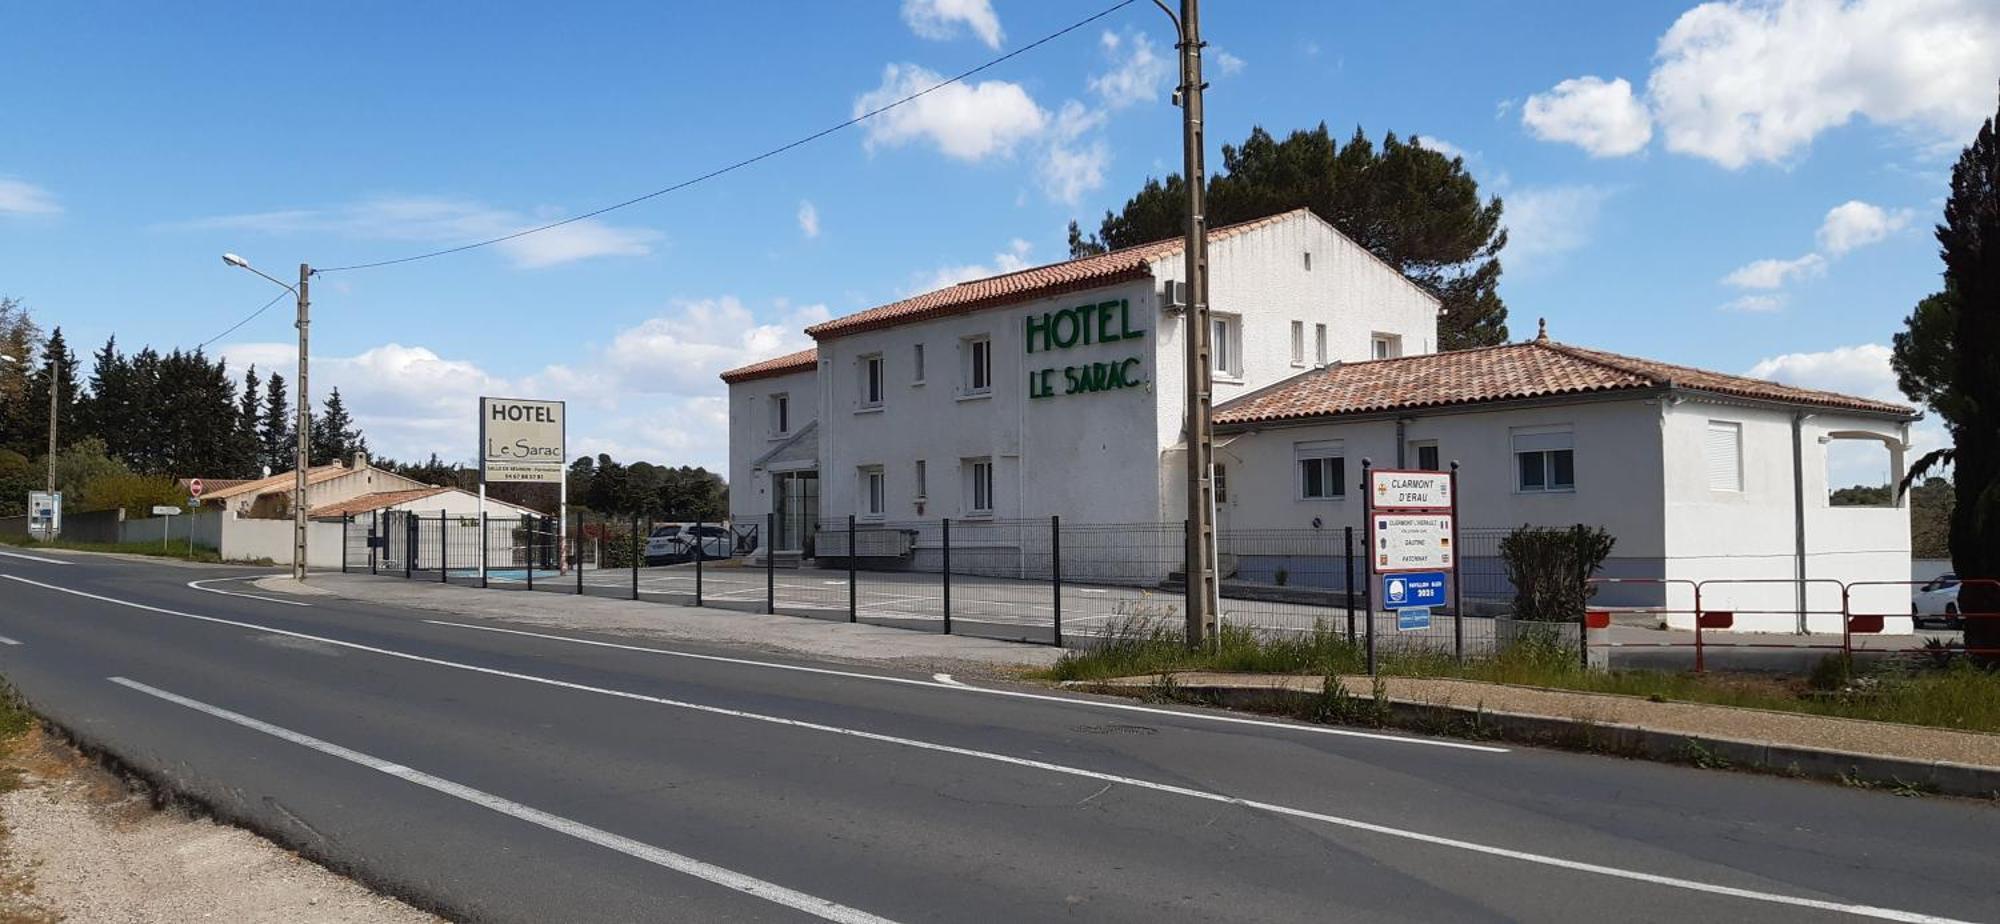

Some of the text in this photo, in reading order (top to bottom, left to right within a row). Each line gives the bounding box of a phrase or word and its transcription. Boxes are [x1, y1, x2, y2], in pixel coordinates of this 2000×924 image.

[1026, 299, 1147, 354] HOTEL
[1030, 357, 1141, 399] LE SARAC
[492, 404, 556, 423] HOTEL
[488, 437, 560, 458] Le Sarac
[1391, 479, 1434, 489] CLARMONT
[1399, 493, 1428, 502] D'ERAU
